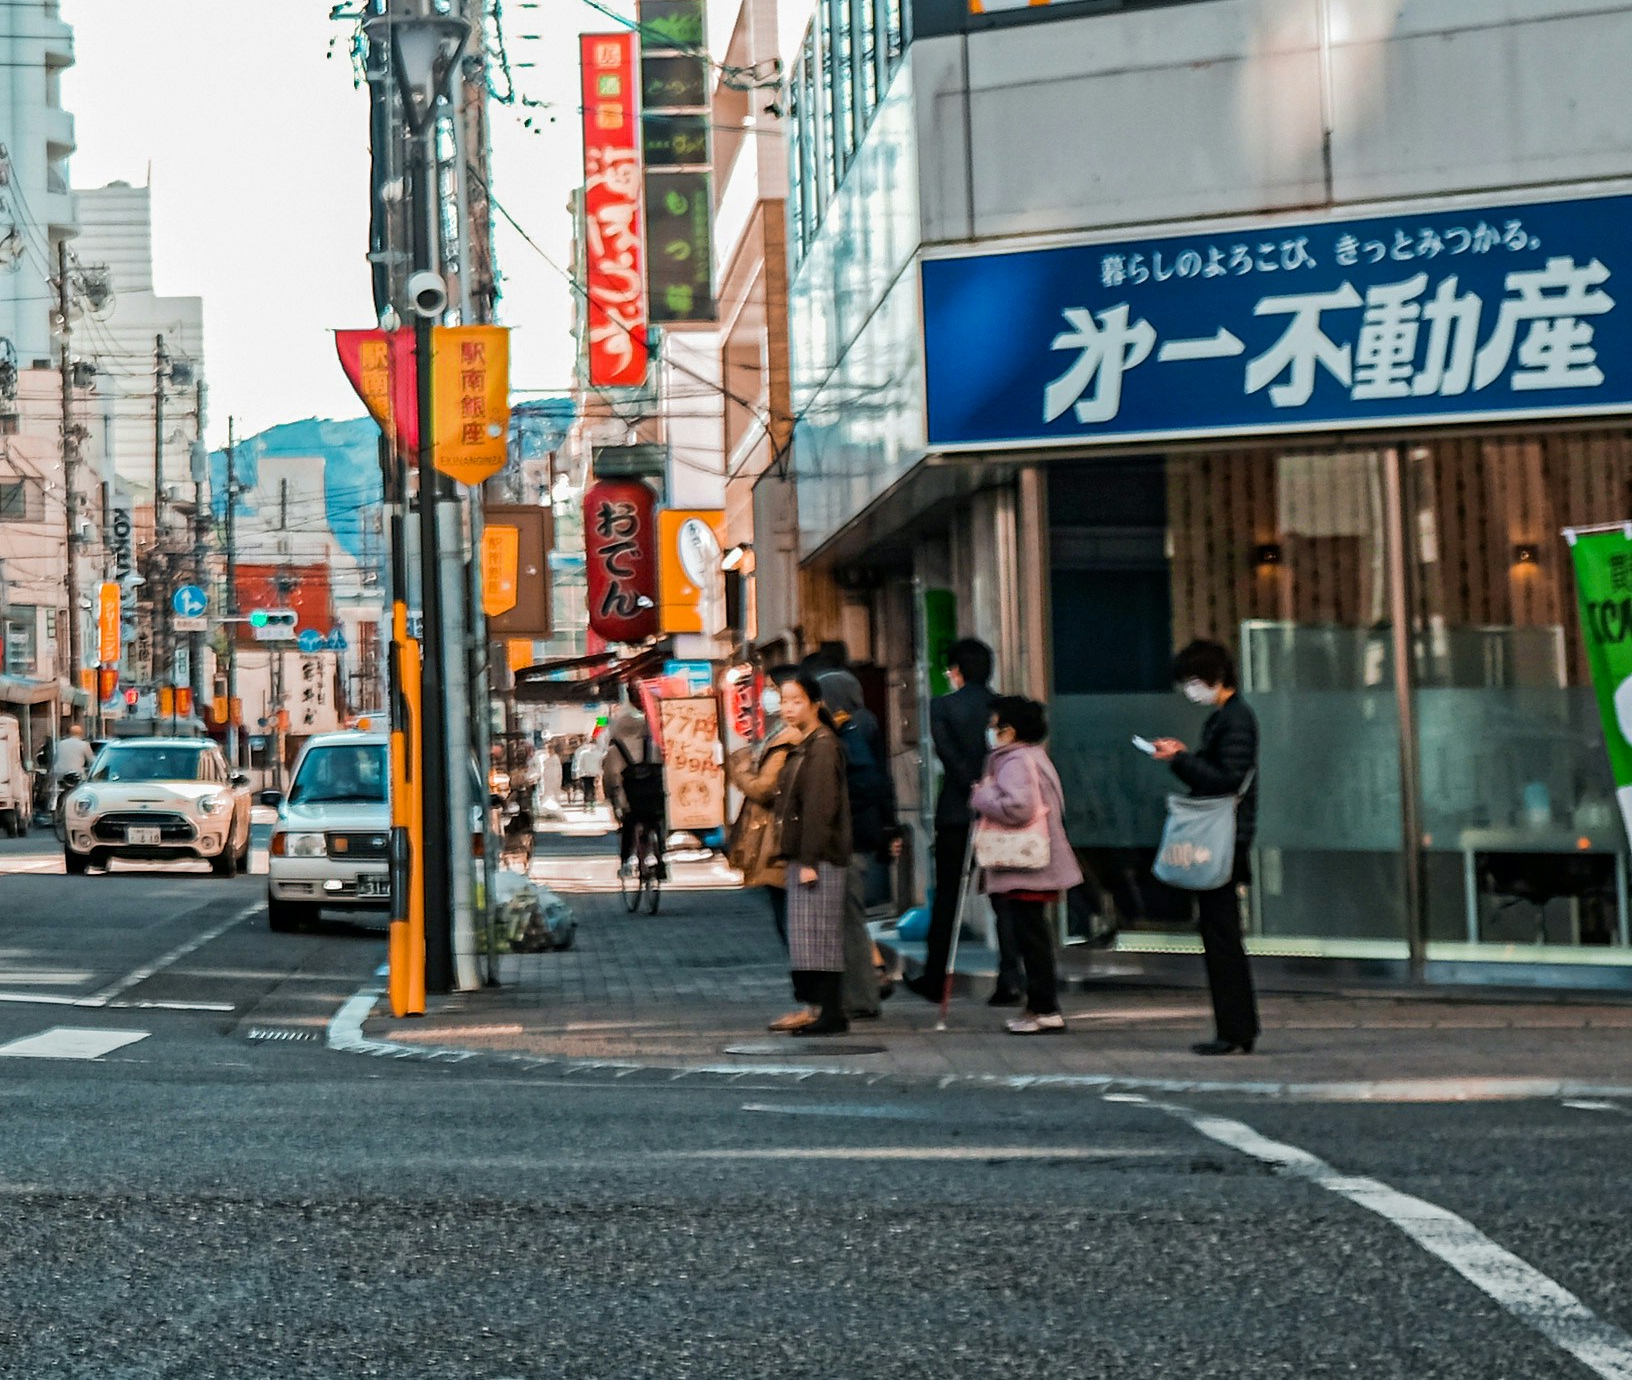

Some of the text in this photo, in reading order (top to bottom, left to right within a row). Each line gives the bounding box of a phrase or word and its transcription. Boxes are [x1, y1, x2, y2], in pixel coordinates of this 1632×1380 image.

[1099, 219, 1542, 287] 暮らしのよろこび、きっとみつかる。
[461, 341, 486, 446] 駅南銀座
[1043, 256, 1616, 425] 第一不動産
[596, 501, 641, 619] おでん
